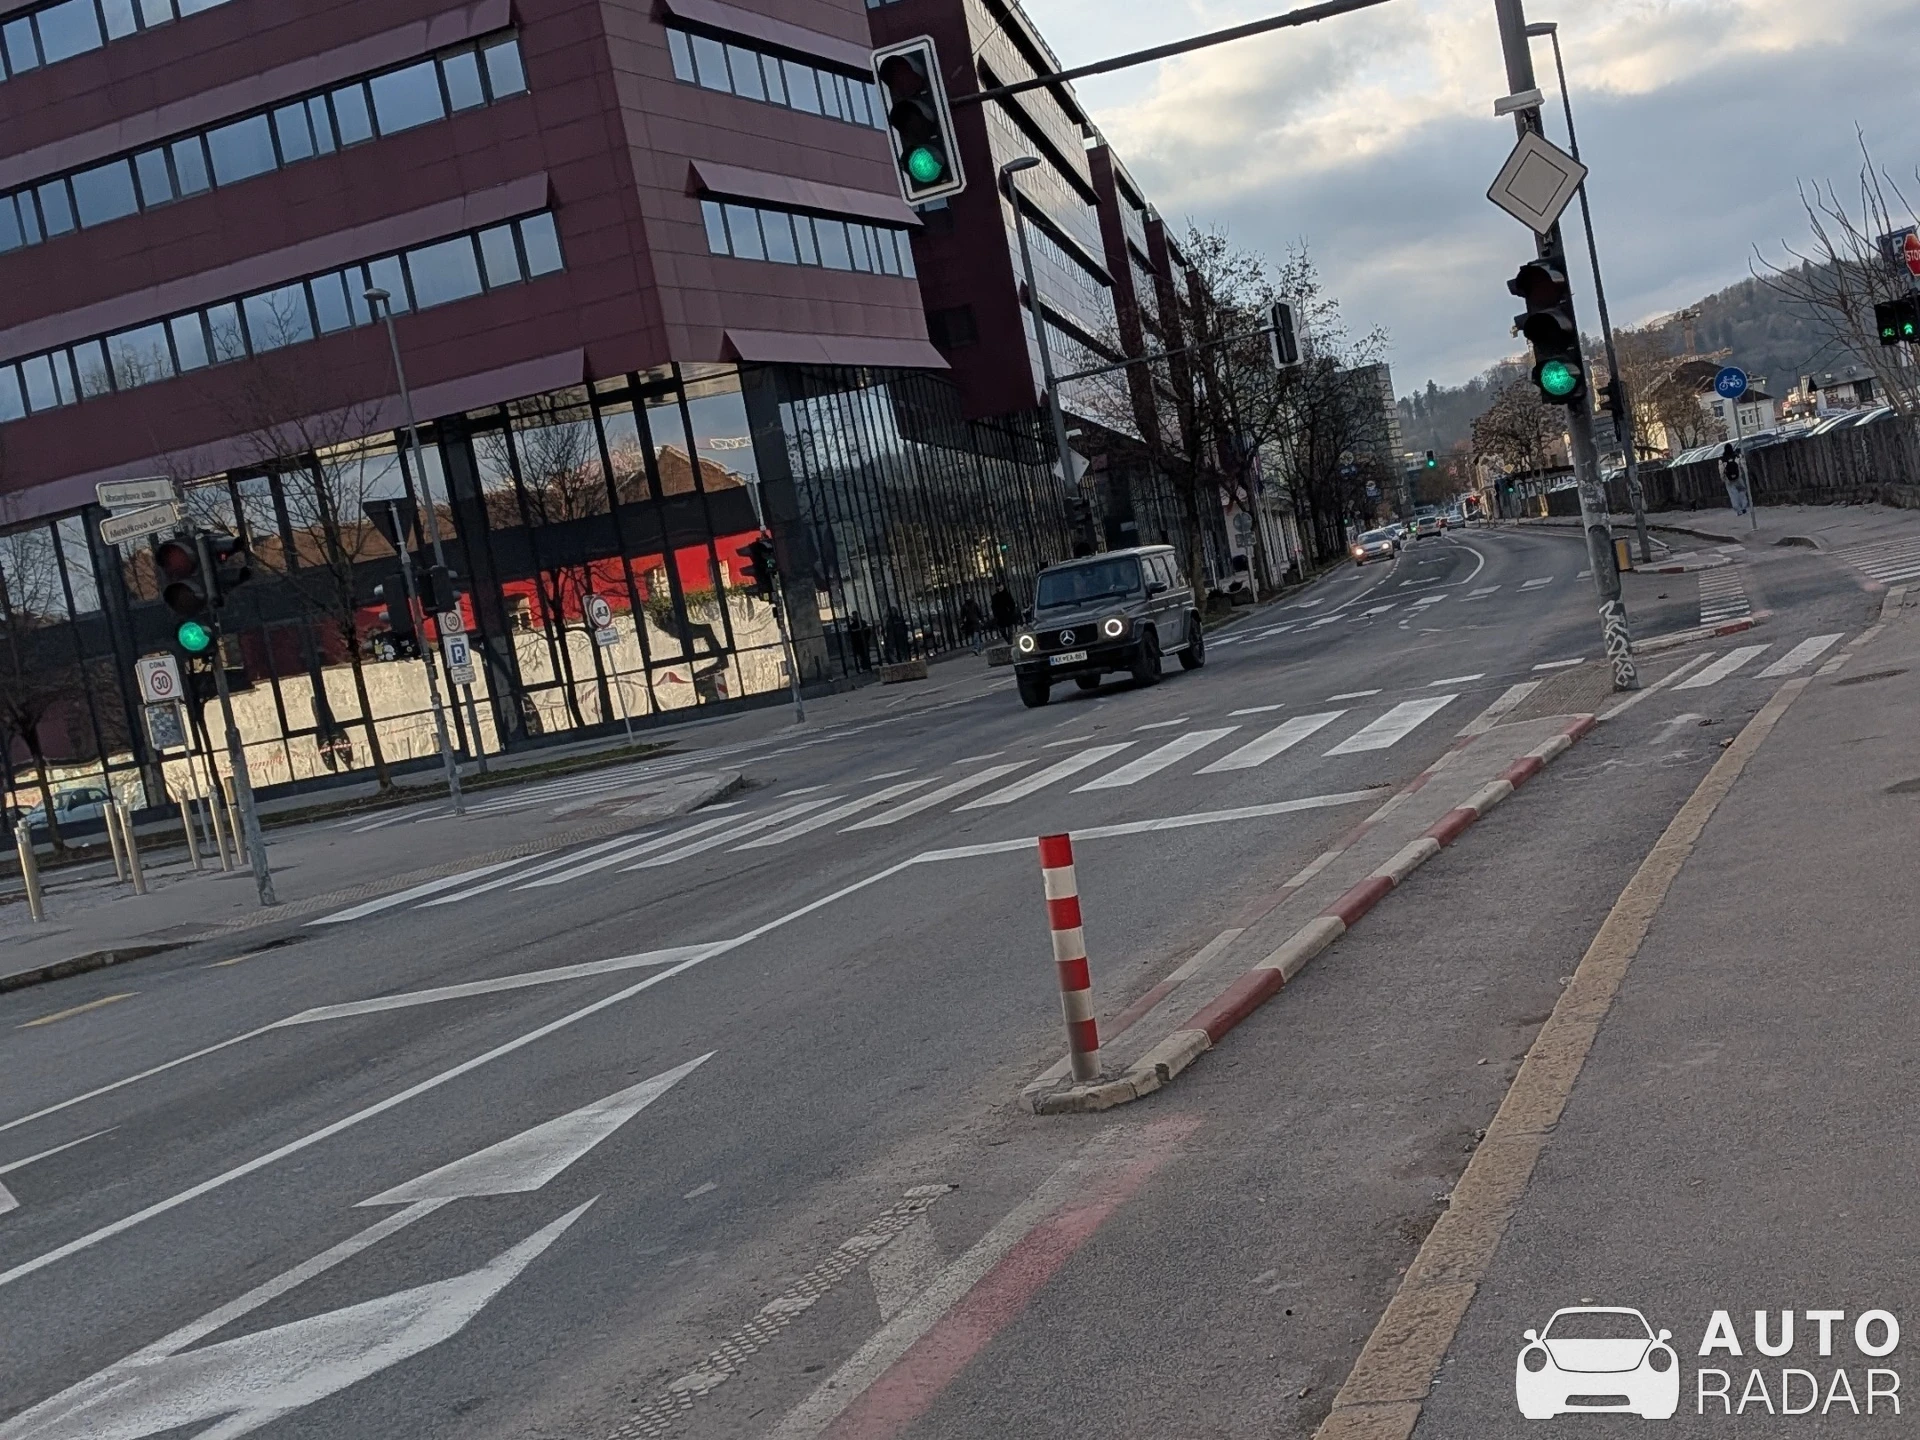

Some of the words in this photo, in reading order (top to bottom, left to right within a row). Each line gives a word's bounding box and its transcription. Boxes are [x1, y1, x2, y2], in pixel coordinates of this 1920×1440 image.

[109, 521, 148, 538] Metelkova
[149, 516, 166, 527] ulica
[447, 616, 457, 627] 30
[149, 661, 166, 669] CONA
[155, 675, 168, 689] 30
